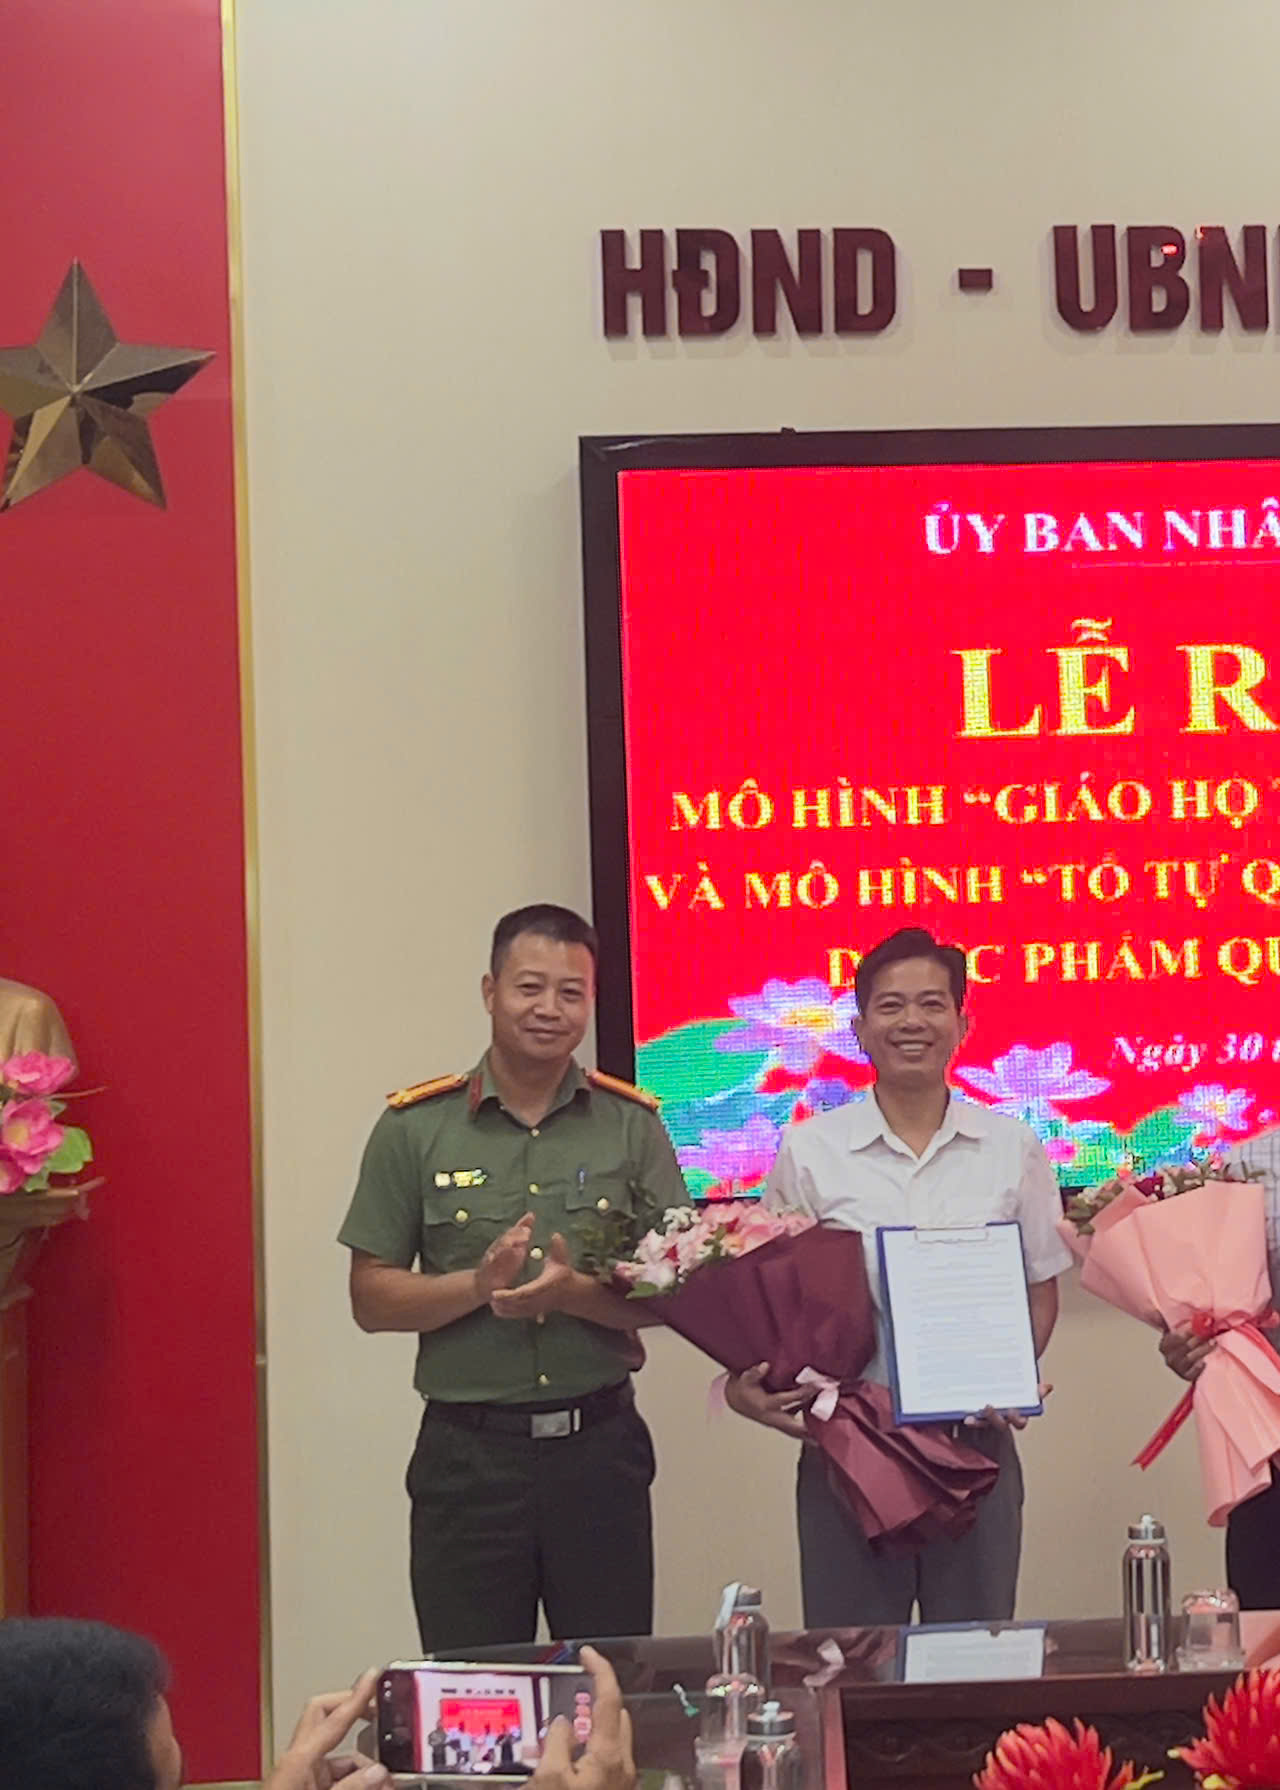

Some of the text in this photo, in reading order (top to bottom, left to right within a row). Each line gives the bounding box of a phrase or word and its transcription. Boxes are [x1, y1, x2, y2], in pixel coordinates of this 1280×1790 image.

[600, 228, 897, 338] HĐND
[924, 502, 1006, 554] ỦY
[1023, 511, 1145, 553] BAN
[951, 618, 1136, 738] LỄ
[670, 778, 774, 831] MÔ
[792, 777, 945, 828] HÌNH
[1171, 777, 1258, 829] HỌ
[644, 862, 724, 910] VÀ
[744, 860, 839, 909] MÔ
[858, 857, 1003, 906] HÌNH
[1144, 852, 1229, 908] TỰ
[826, 944, 1004, 987] DC
[1112, 1033, 1208, 1073] Ngày
[1216, 1032, 1264, 1064] 30
